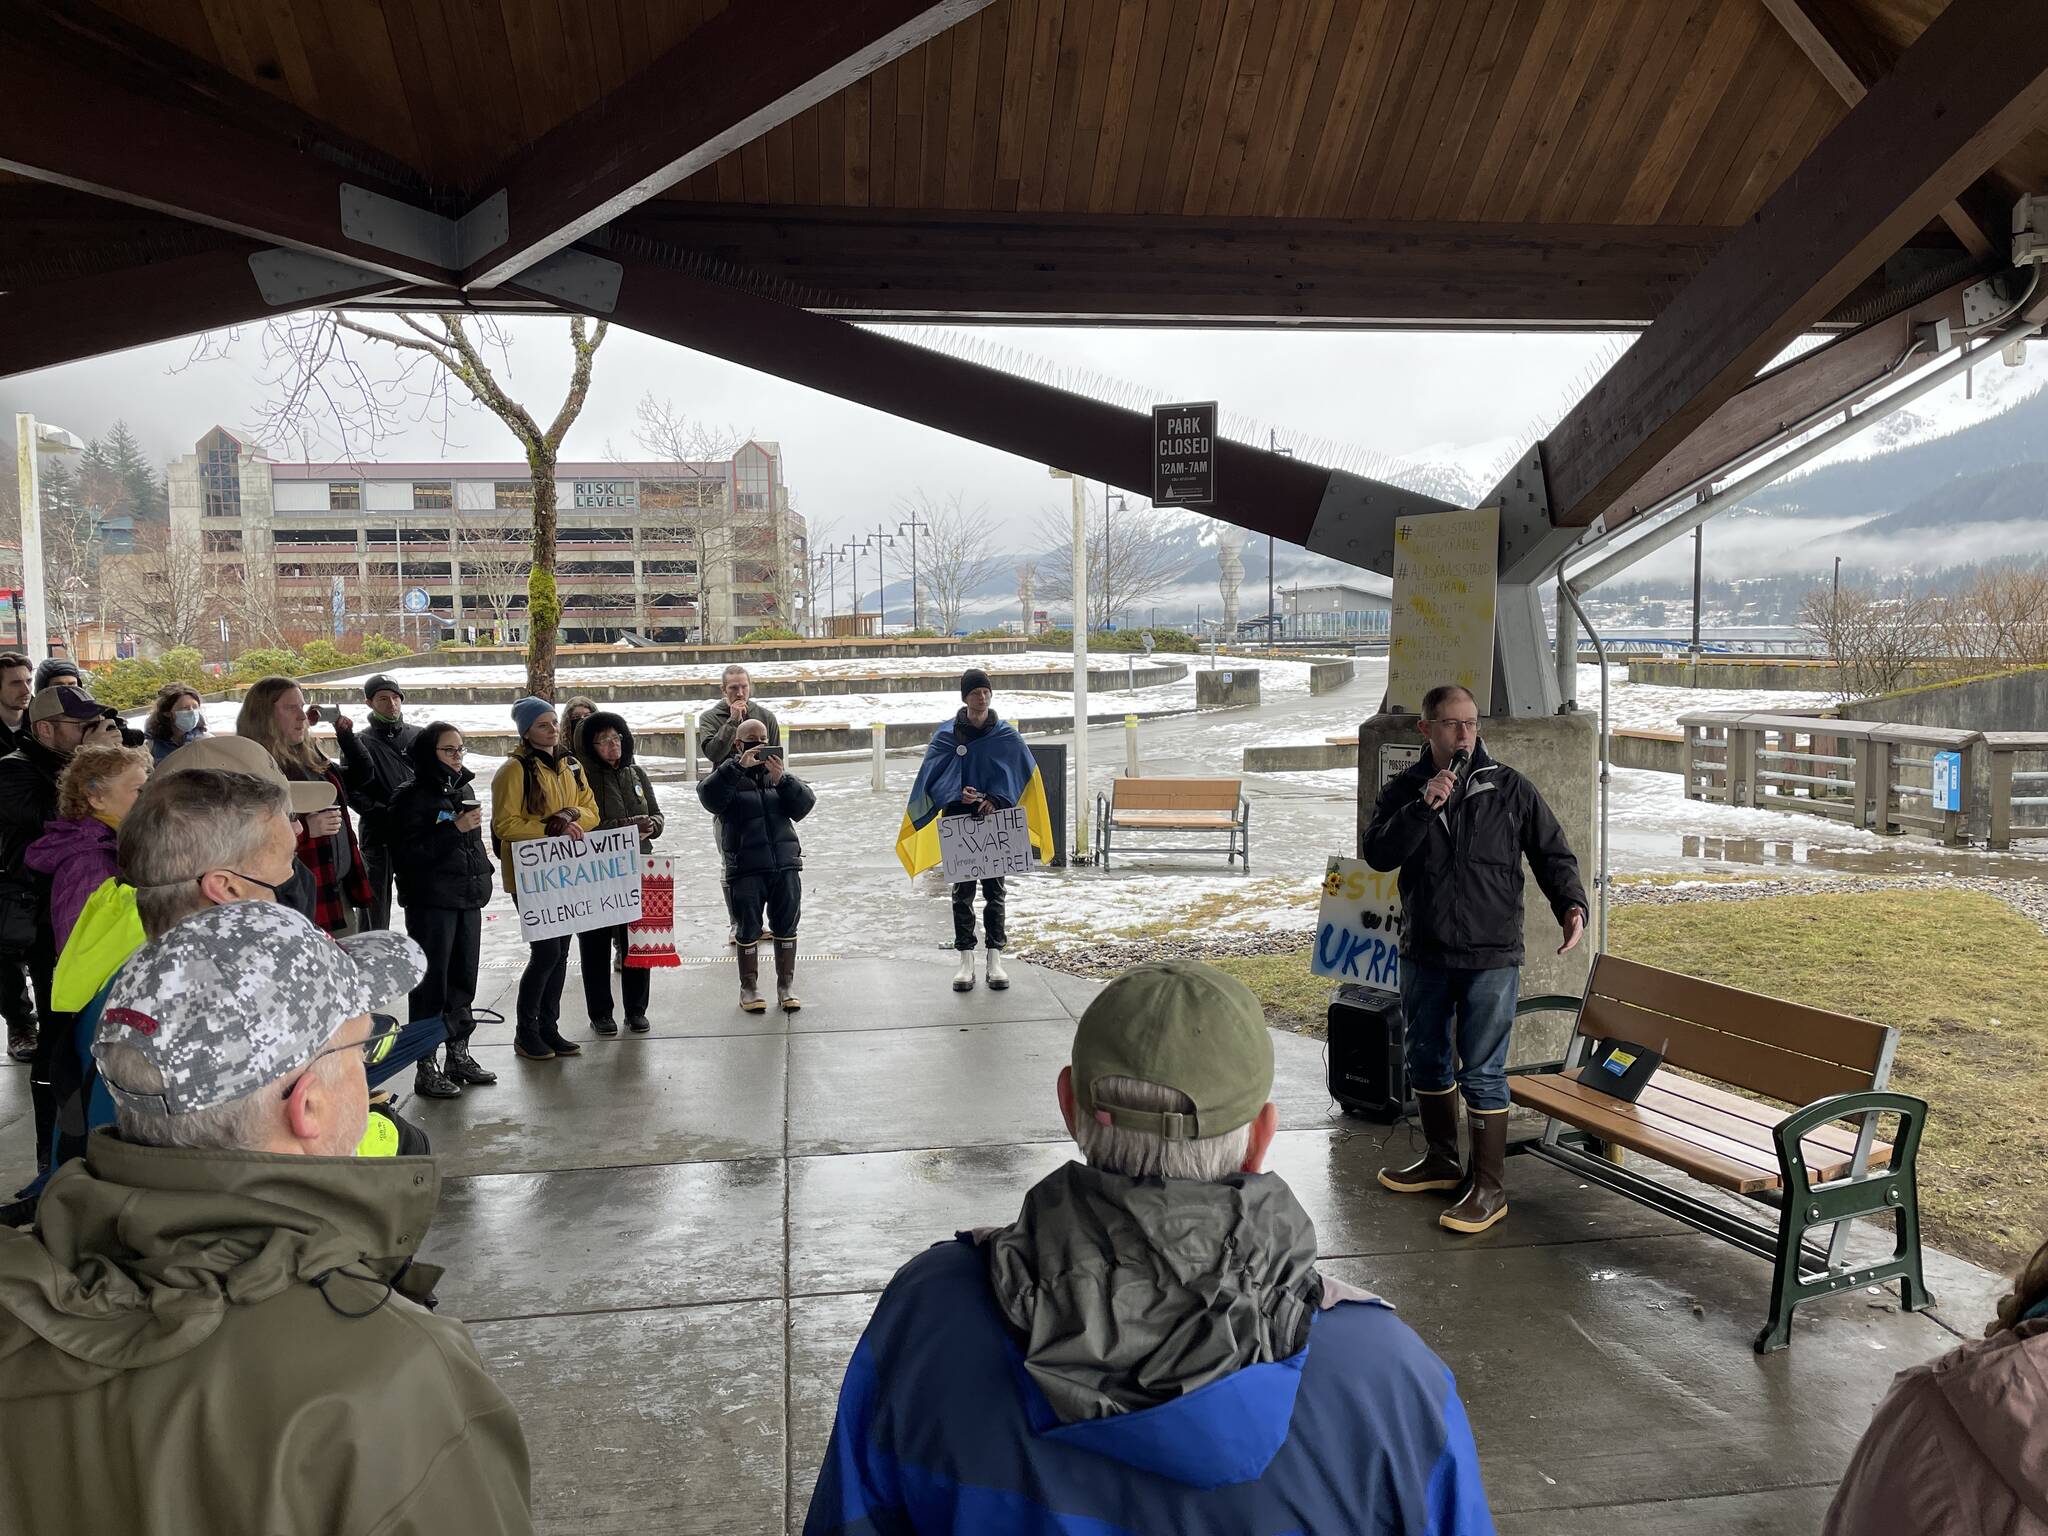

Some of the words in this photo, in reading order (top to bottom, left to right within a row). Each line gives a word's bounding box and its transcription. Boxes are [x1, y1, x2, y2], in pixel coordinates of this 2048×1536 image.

[1167, 417, 1200, 435] PARK
[1159, 437, 1209, 456] CLOSED
[1161, 461, 1207, 474] 12AM-7AM
[575, 483, 614, 494] RISK
[942, 814, 985, 838] STOP
[993, 808, 1024, 831] THE
[519, 839, 587, 866] STAND
[590, 831, 635, 854] WITH
[962, 831, 1010, 853] WAR
[520, 850, 638, 894] UKRAINE!
[971, 865, 986, 877] ON
[993, 851, 1029, 874] FIRE!
[523, 900, 593, 926] SILENCE
[600, 889, 640, 911] KILLS
[1320, 923, 1399, 987] UKRA
